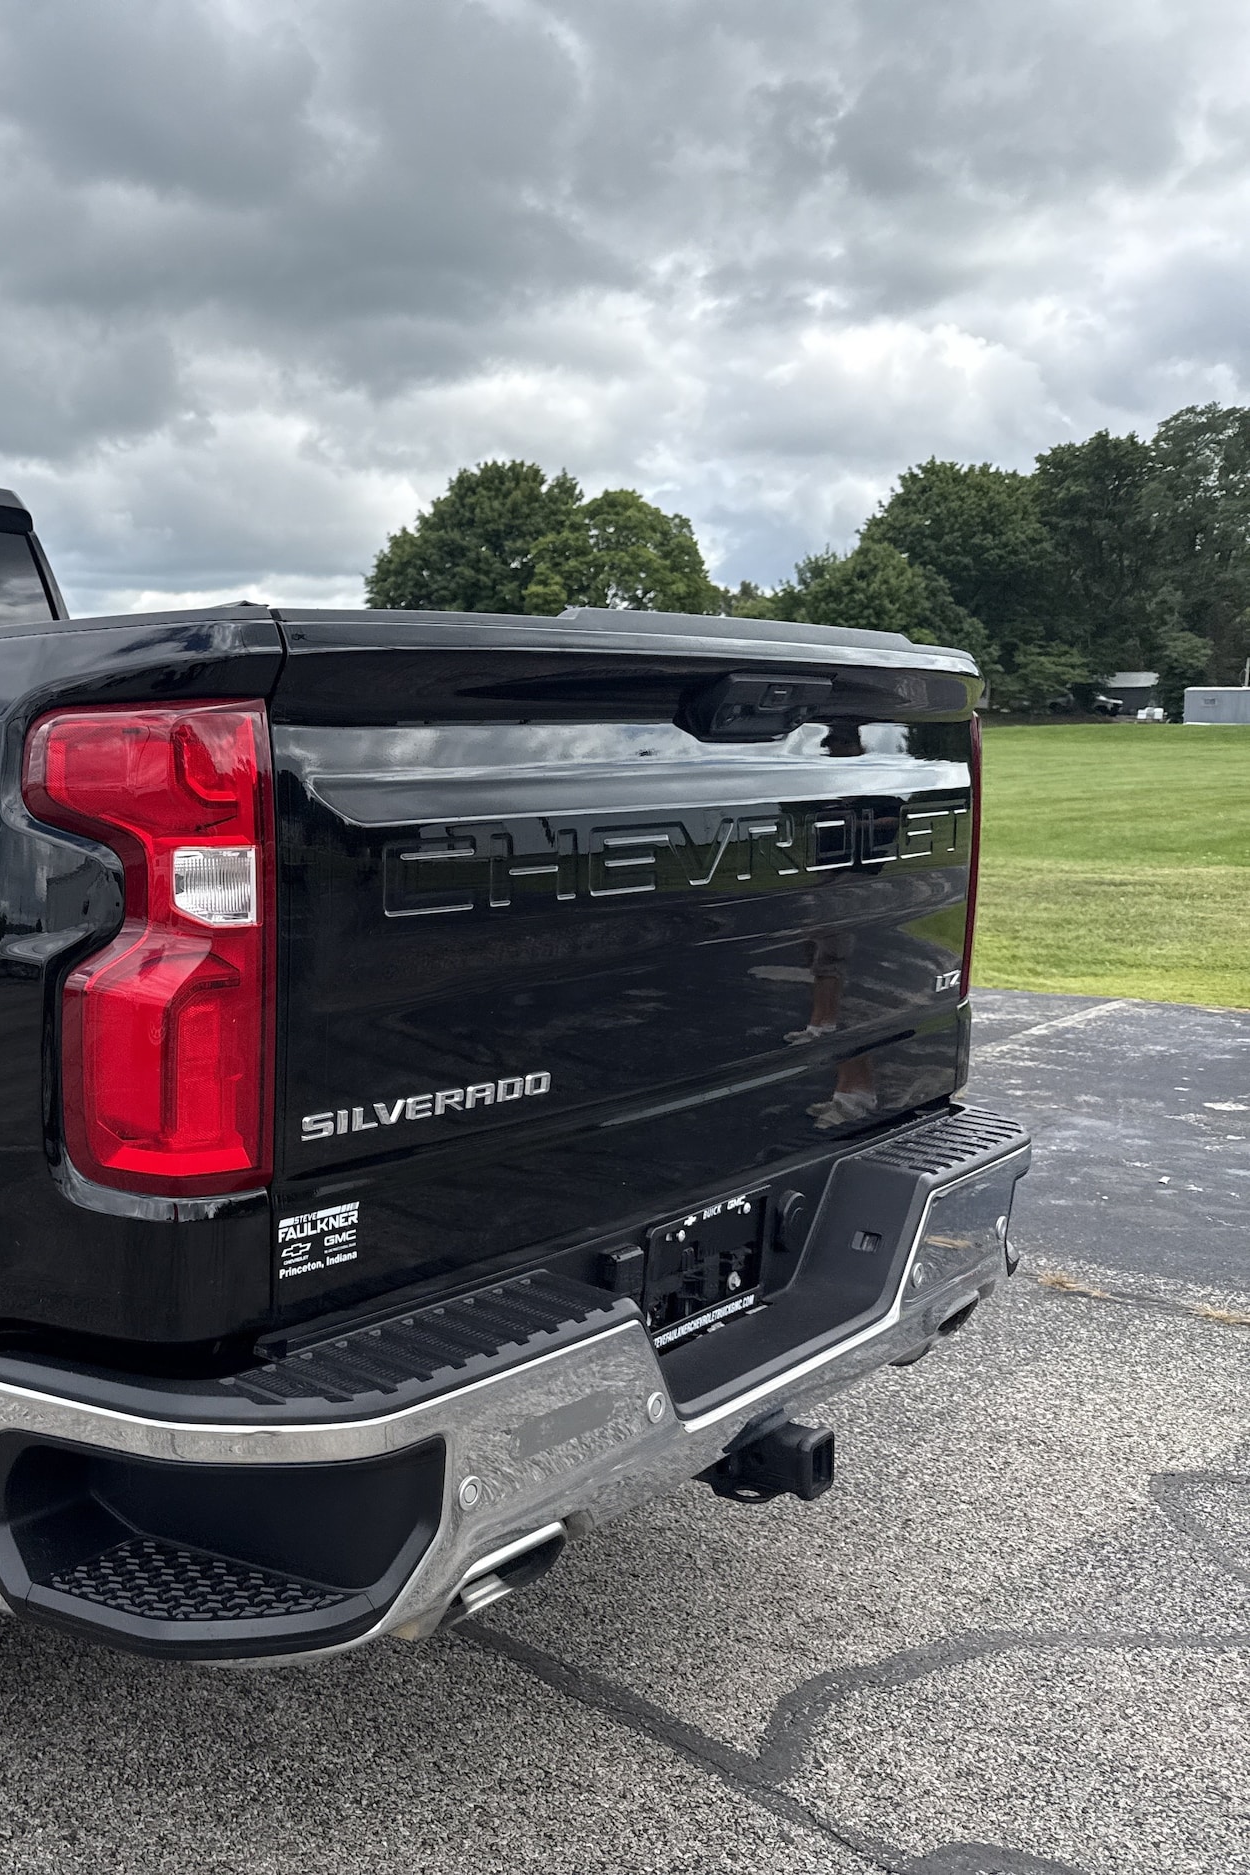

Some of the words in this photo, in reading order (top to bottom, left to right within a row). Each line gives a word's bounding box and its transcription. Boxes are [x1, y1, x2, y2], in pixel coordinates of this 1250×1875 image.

[383, 802, 968, 918] CHEVROLET
[935, 969, 961, 992] LTZ
[301, 1071, 551, 1142] SILVERADO
[293, 1211, 318, 1225] STEVE
[702, 1204, 722, 1220] BUICK
[726, 1195, 746, 1211] GMC
[278, 1210, 359, 1243] FAULKNER
[323, 1229, 357, 1247] GMC
[279, 1260, 325, 1280] Princeton,
[326, 1250, 358, 1267] Indiana
[653, 1294, 755, 1349] TEVEFAULKNERCHEVROLETBUICKGMC.COM
